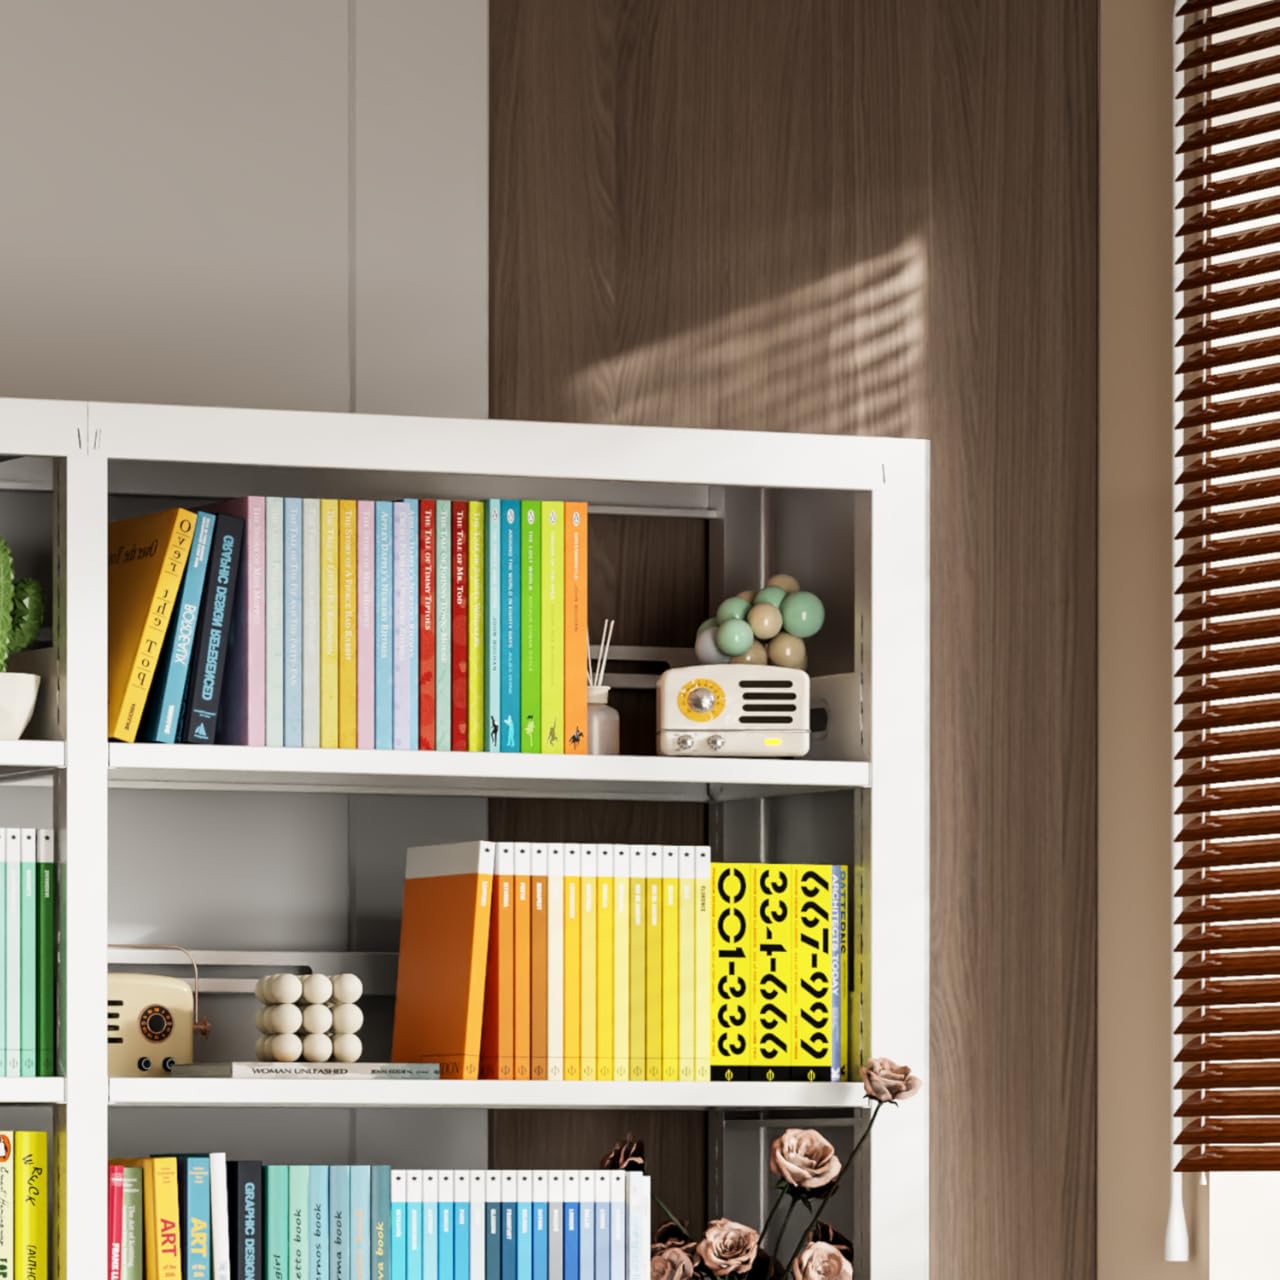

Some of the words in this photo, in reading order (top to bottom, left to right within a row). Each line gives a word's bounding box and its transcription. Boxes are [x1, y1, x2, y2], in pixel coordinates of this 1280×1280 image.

[424, 510, 432, 527] THE
[456, 511, 464, 528] THE
[424, 530, 432, 550] TALE
[456, 531, 464, 552] TALE
[424, 552, 432, 564] OF
[456, 554, 464, 565] OF
[424, 567, 432, 594] TIMMY
[456, 567, 464, 584] MR.
[456, 586, 464, 605] TOD
[424, 596, 432, 630] TIPTOES
[760, 869, 788, 1059] 334-666
[800, 870, 829, 1059] 667-999
[831, 954, 839, 996] TODAY
[251, 1067, 292, 1076] WOMAN
[244, 1182, 255, 1236] GRAPHIC
[314, 1203, 322, 1238] book
[160, 1218, 177, 1257] ART
[190, 1216, 208, 1258] ART
[335, 1210, 343, 1245] book
[376, 1222, 385, 1257] book
[274, 1254, 282, 1280] girl
